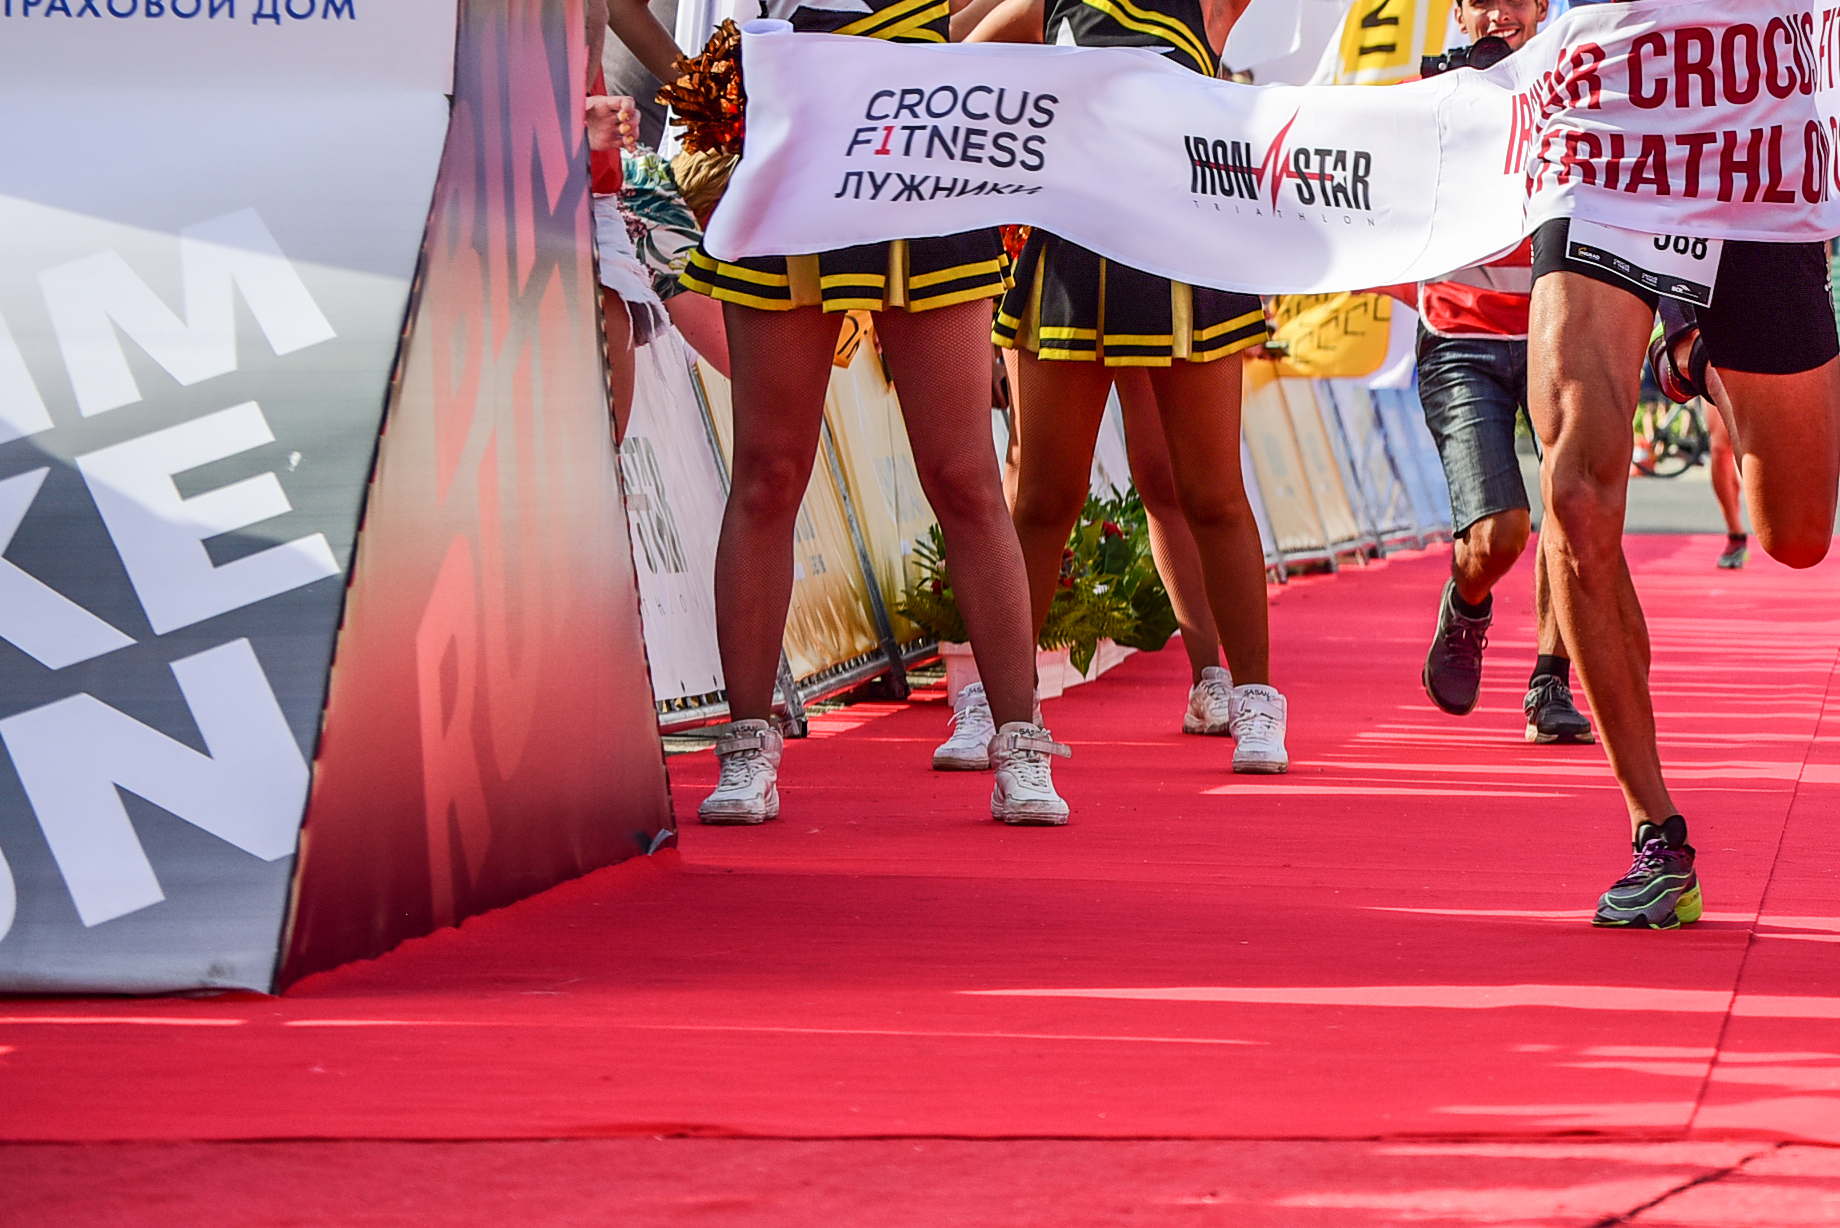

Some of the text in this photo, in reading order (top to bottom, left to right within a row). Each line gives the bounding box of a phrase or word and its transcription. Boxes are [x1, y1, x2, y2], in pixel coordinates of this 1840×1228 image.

[864, 84, 1060, 129] CROCUS
[834, 170, 1044, 202] ЛУЖНИКИ
[1183, 134, 1259, 201] IRON
[1191, 199, 1376, 228] TRIATHLON
